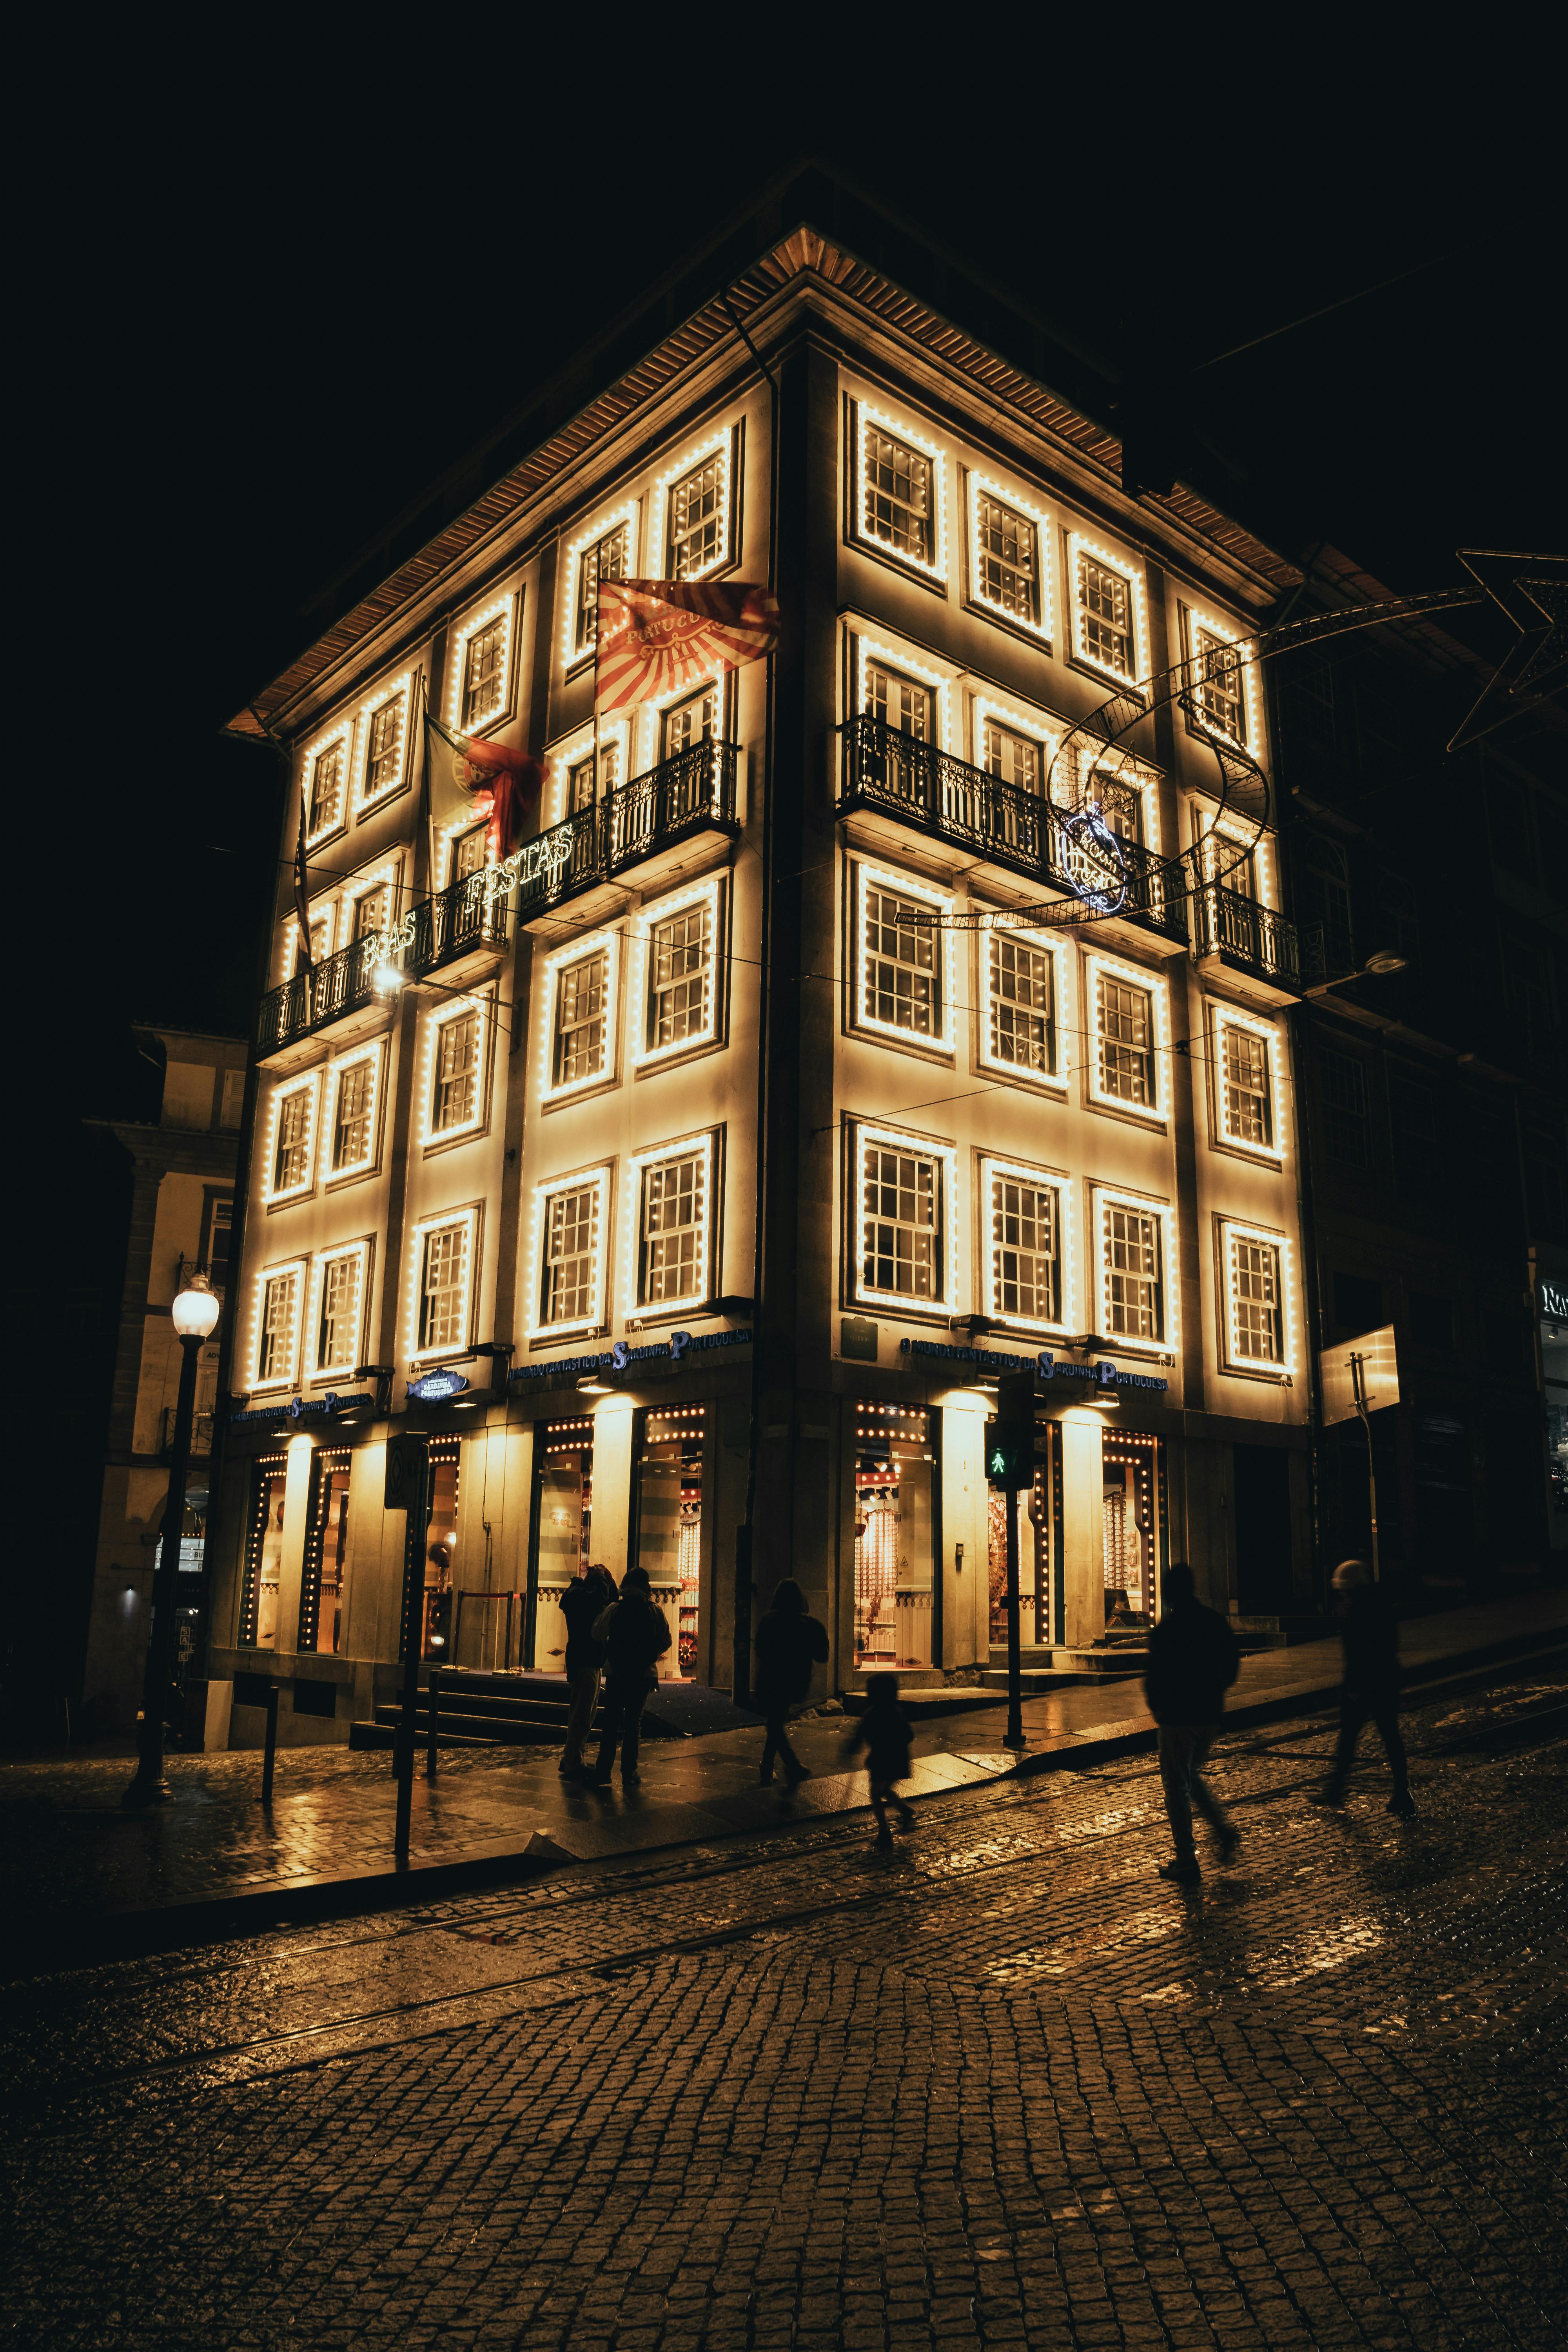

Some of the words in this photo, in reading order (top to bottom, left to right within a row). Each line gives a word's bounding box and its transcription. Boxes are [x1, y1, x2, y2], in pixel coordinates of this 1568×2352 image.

[361, 911, 416, 971] BOAS
[465, 824, 573, 914] FESTAS
[1541, 1284, 1568, 1317] NA
[517, 1364, 544, 1379] MUNDO
[599, 1352, 611, 1366] DA
[912, 1340, 955, 1358] MUNDO
[1022, 1357, 1037, 1371] DA
[421, 1386, 453, 1397] PORTUGUESA
[424, 1381, 451, 1390] SARDINHA
